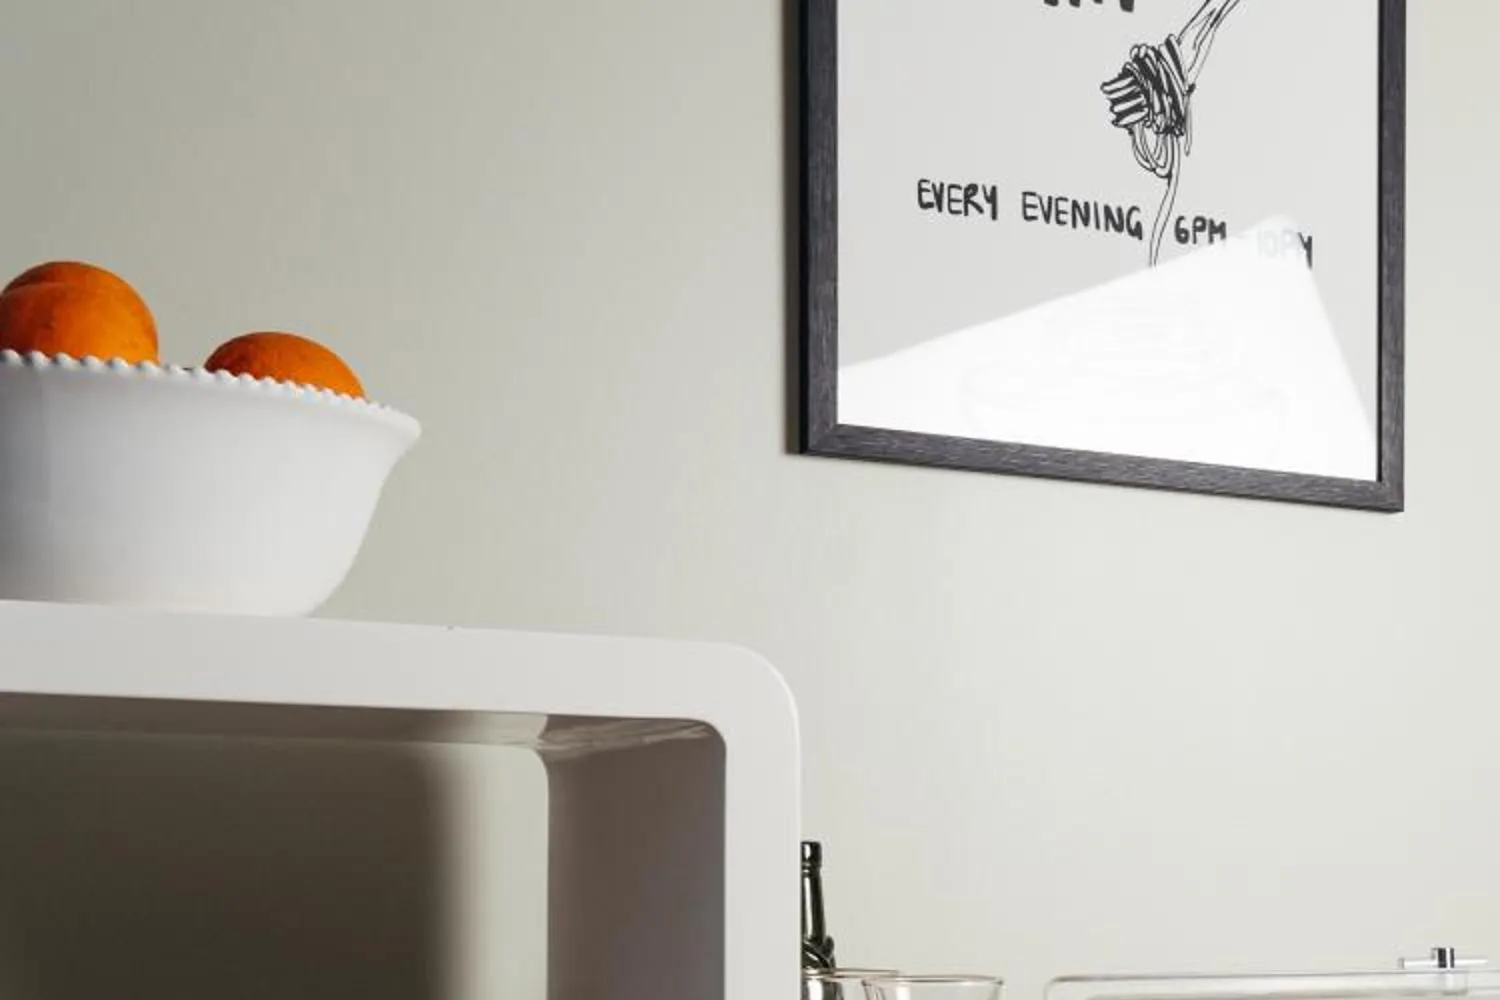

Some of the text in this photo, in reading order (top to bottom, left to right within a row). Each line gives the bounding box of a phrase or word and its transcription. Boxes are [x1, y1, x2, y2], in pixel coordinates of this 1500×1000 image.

[917, 179, 998, 221] EVERY
[1021, 191, 1143, 240] EVENING
[1174, 215, 1227, 245] 6PM
